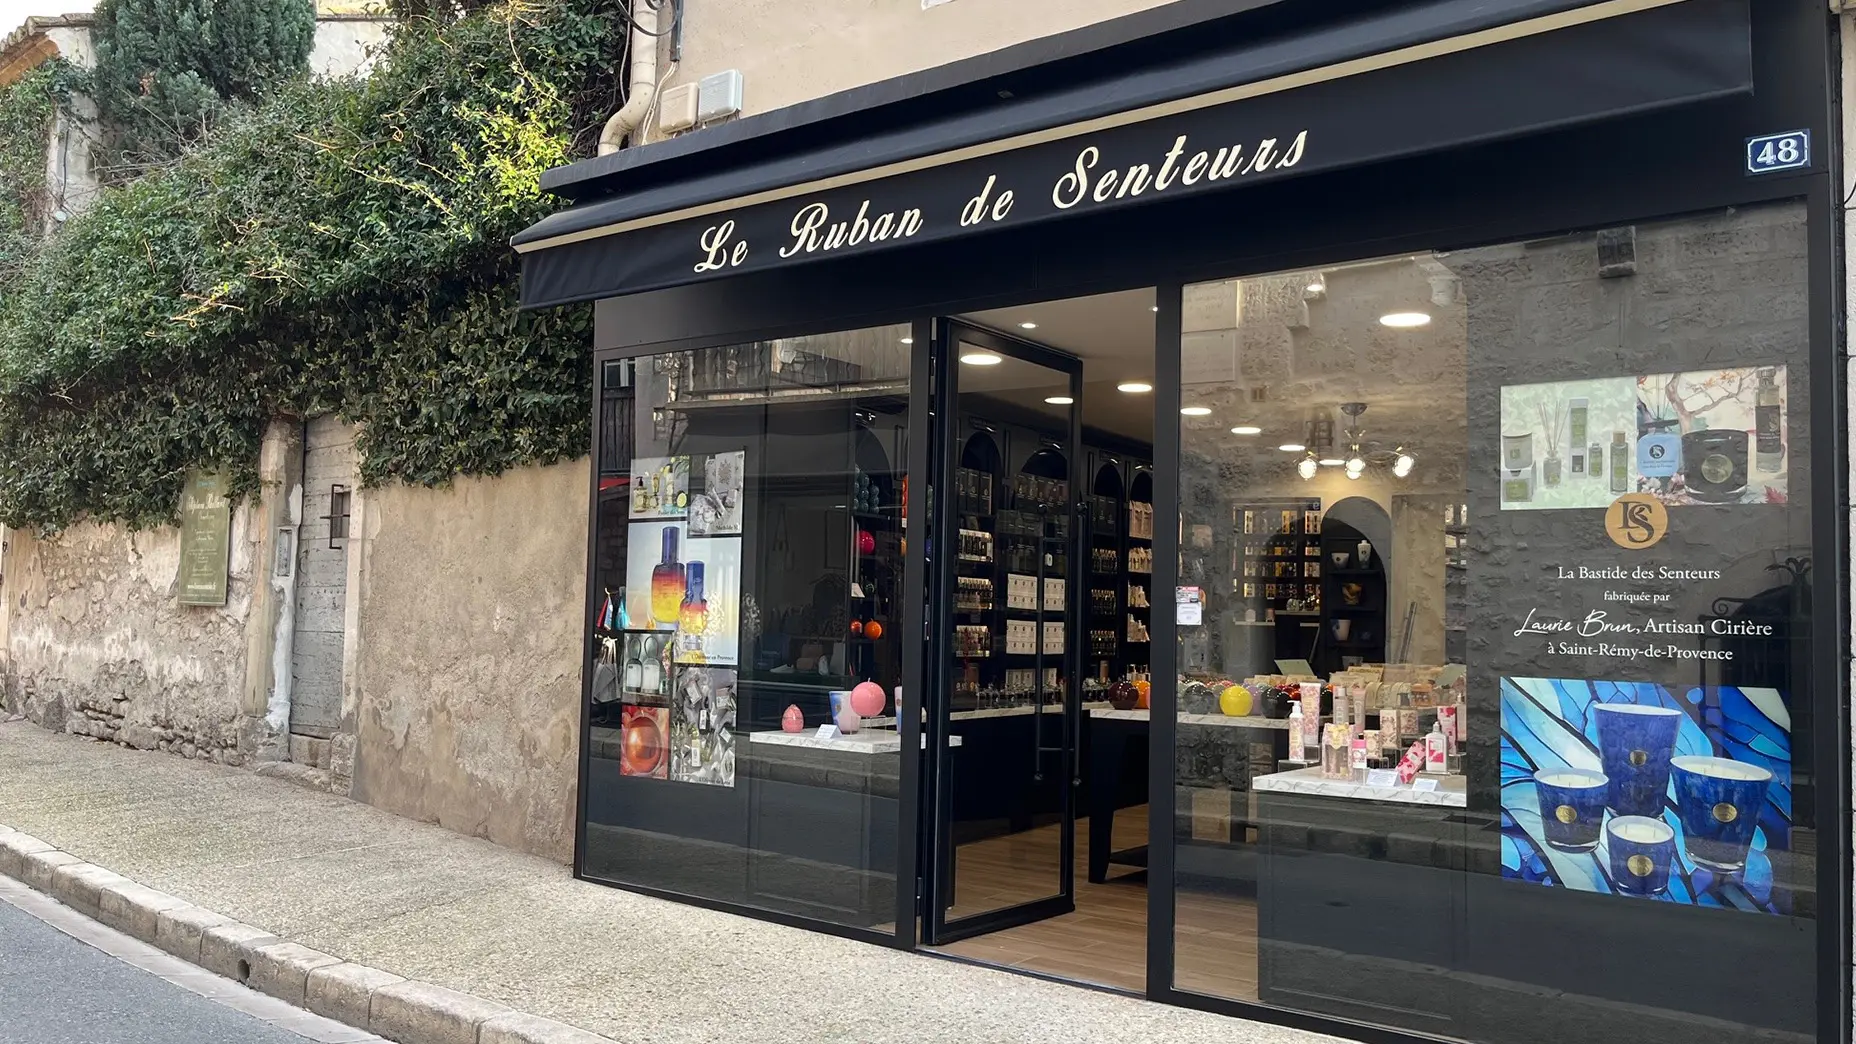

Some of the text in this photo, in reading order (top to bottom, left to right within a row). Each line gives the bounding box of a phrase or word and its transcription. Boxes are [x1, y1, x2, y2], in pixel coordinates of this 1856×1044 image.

[1756, 138, 1799, 165] 48
[692, 129, 1309, 273] Le Ruban de Senteurs
[1557, 565, 1721, 580] La Bastide des Senteurs
[1603, 590, 1671, 604] fabriquée par
[1513, 607, 1773, 637] Laurie Brun, Artisan Cirière
[1547, 641, 1733, 661] à Saint-Rémy-de-Provence
